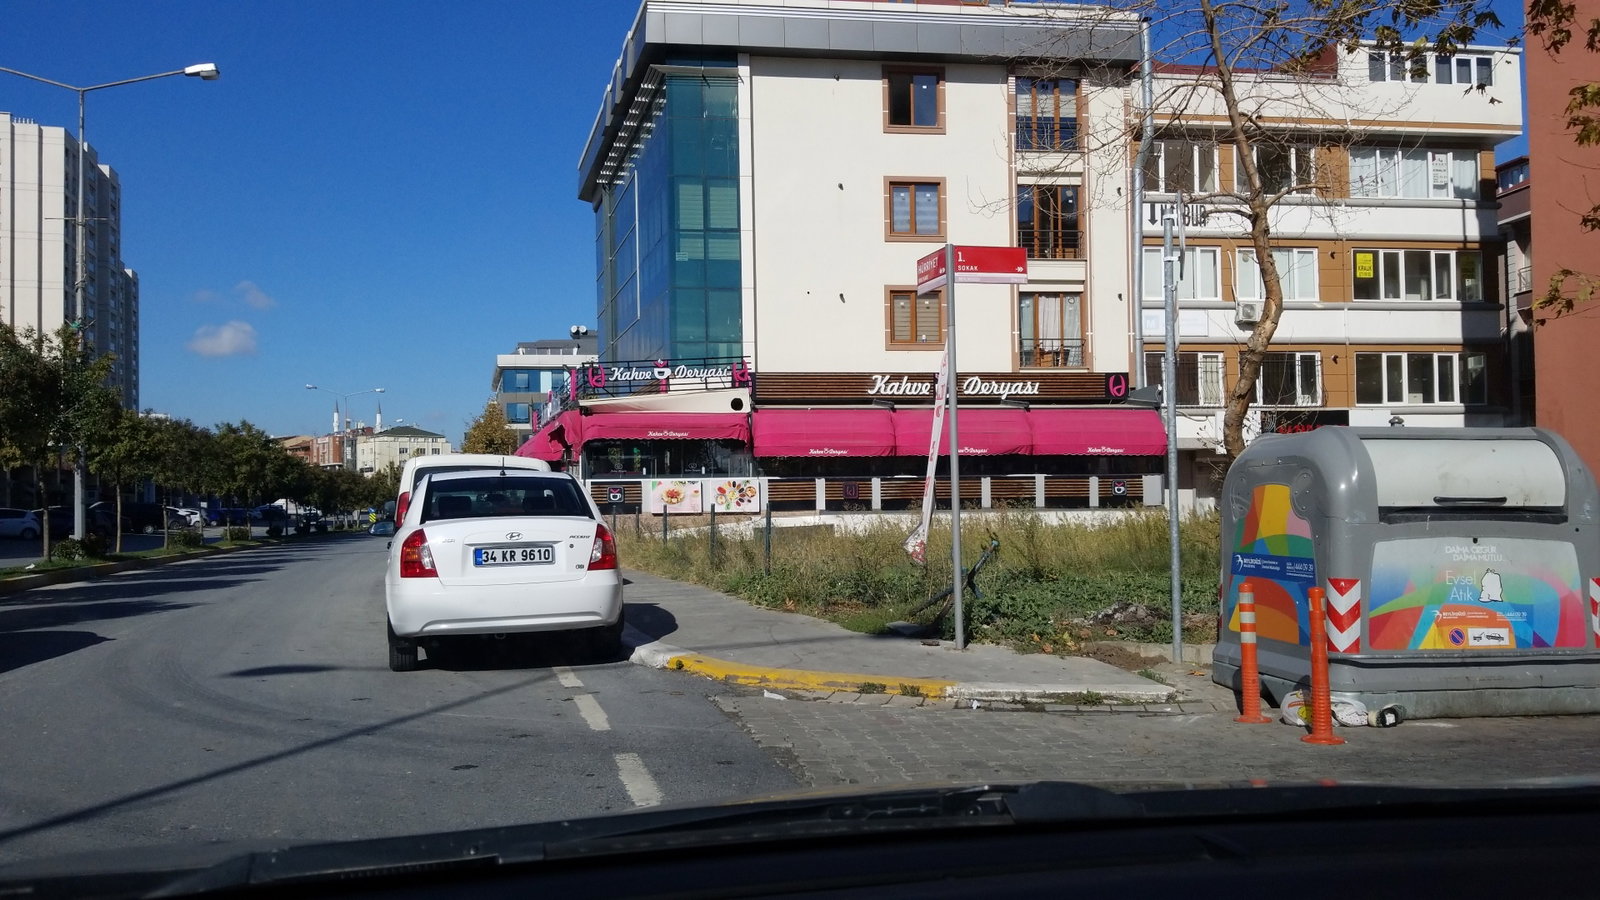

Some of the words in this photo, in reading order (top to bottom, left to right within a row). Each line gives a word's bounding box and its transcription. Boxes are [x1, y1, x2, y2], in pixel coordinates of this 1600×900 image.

[958, 251, 966, 262] 1.
[608, 366, 652, 381] Kahve
[867, 375, 931, 395] Kahve
[483, 551, 497, 562] 34
[502, 550, 516, 562] KR
[521, 549, 550, 561] 9610
[1445, 570, 1477, 586] Evsel
[1450, 587, 1473, 602] Atık
